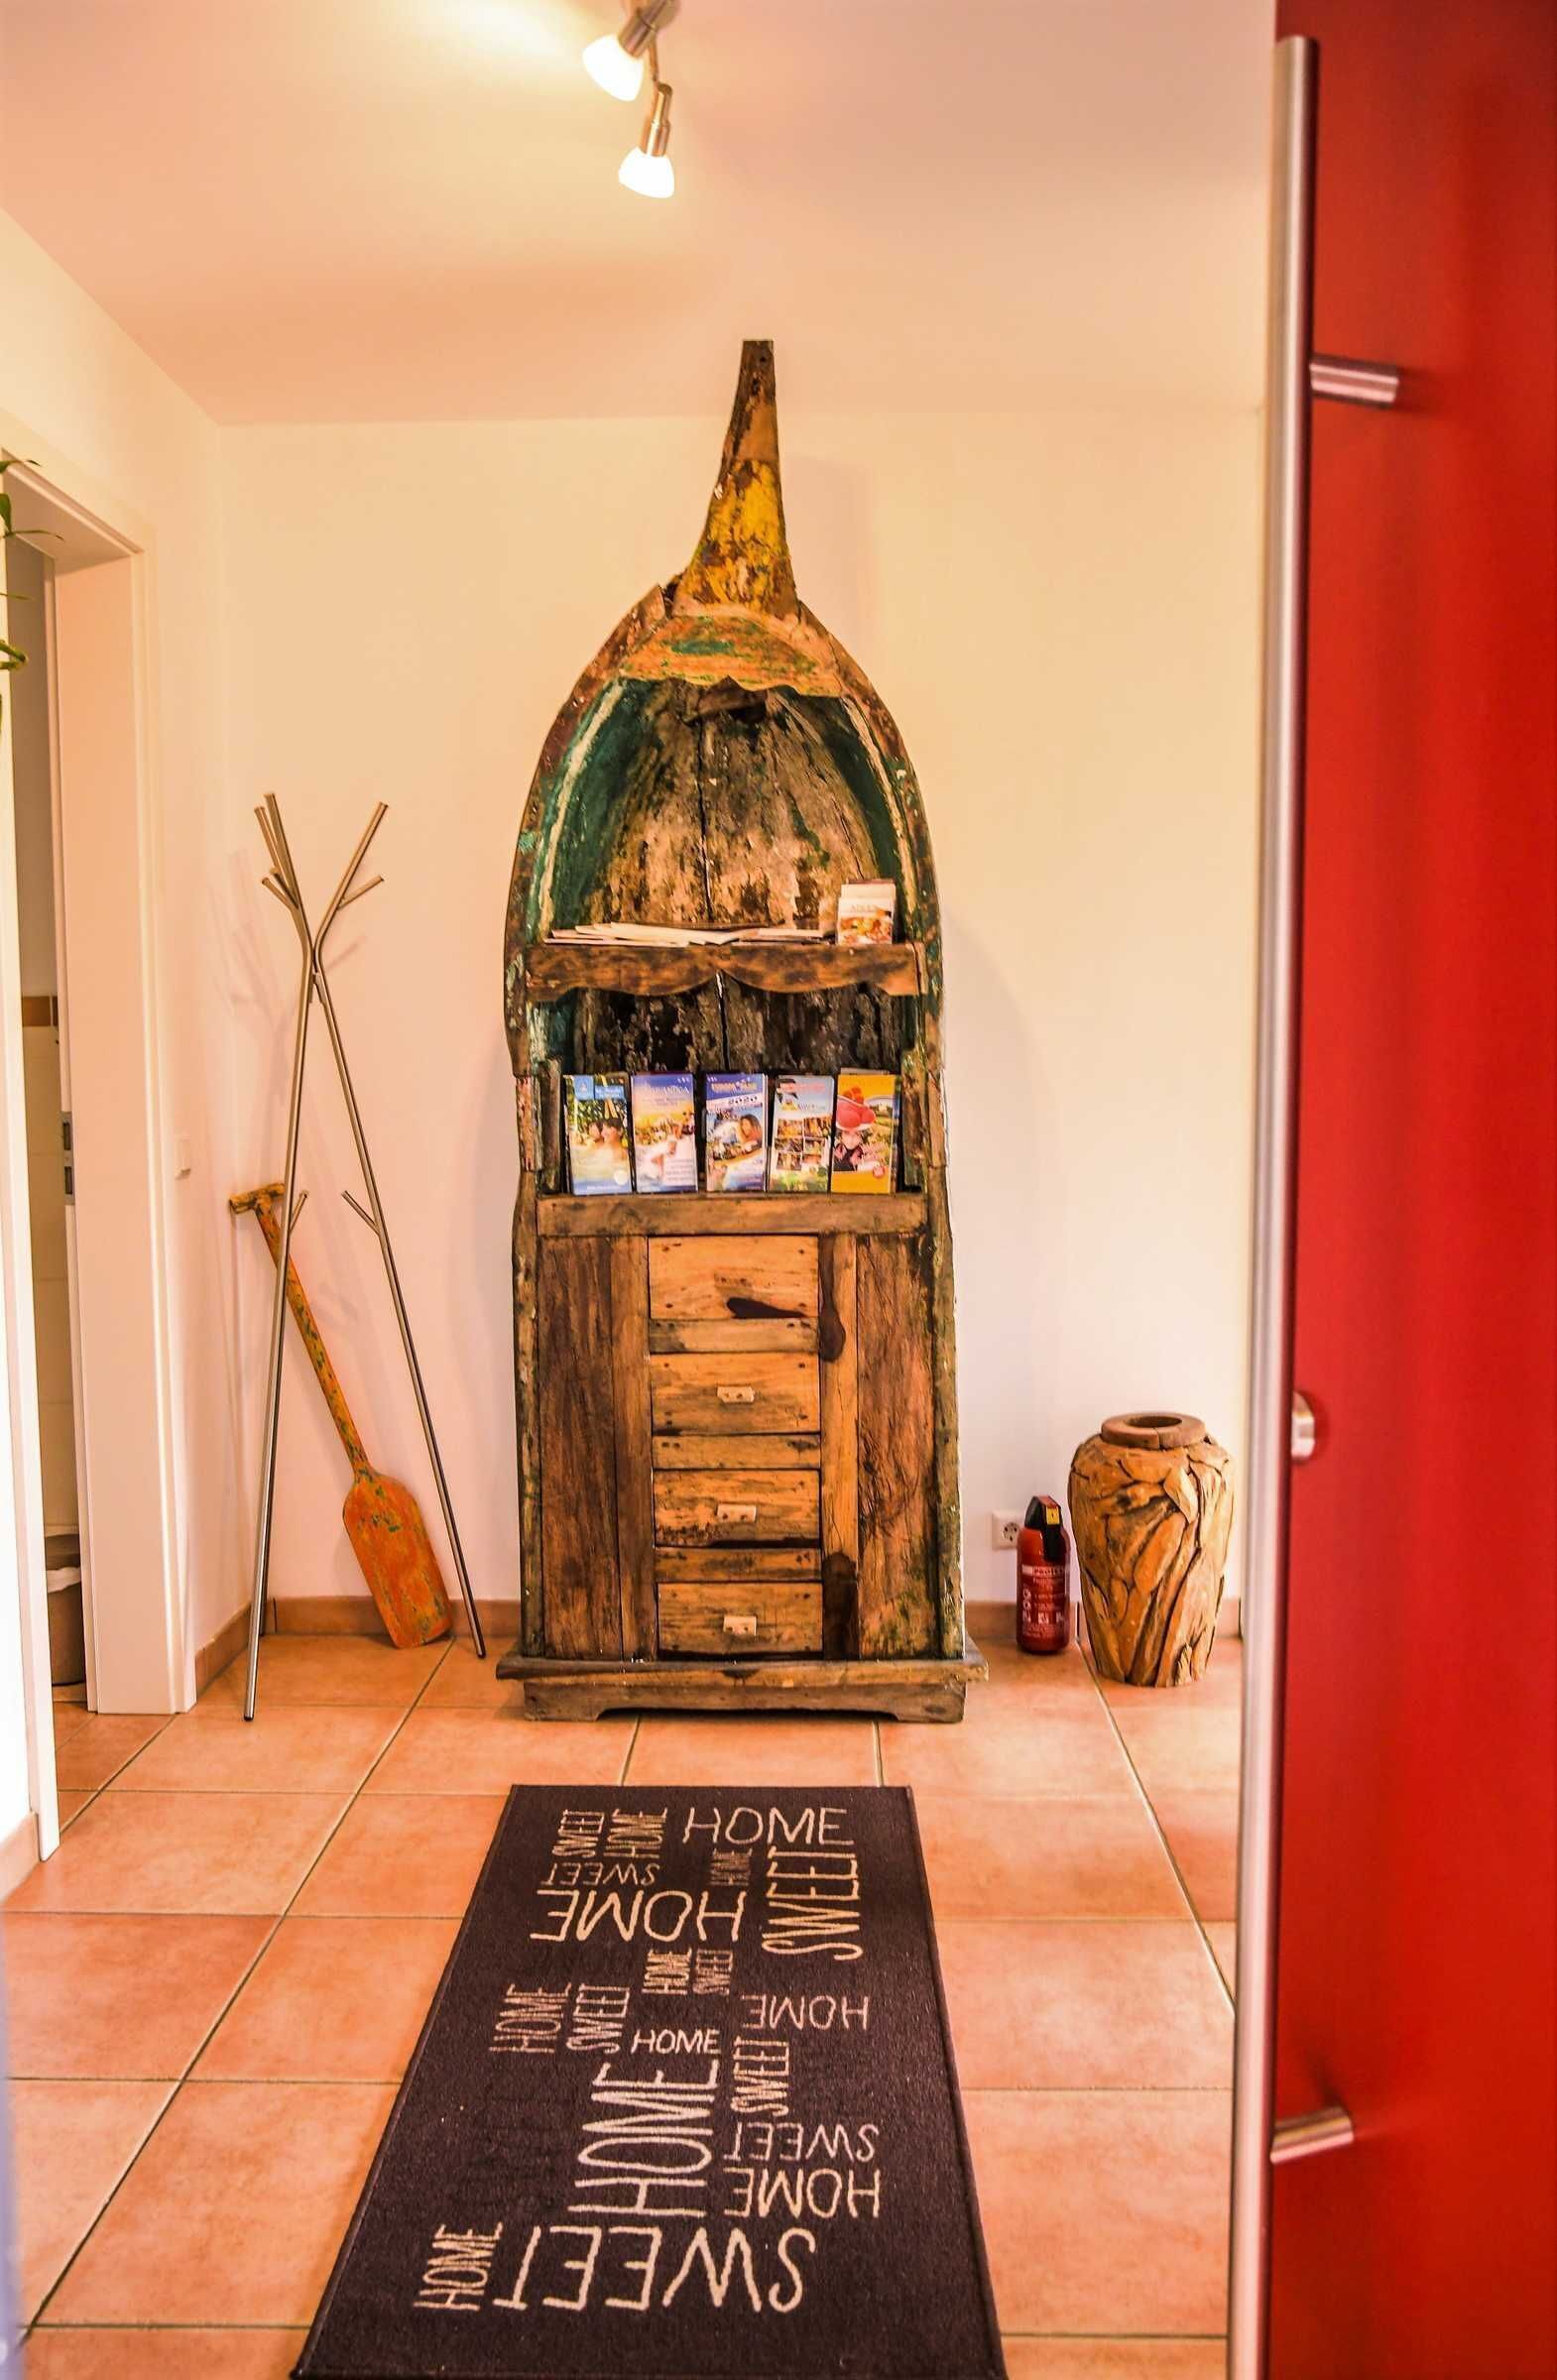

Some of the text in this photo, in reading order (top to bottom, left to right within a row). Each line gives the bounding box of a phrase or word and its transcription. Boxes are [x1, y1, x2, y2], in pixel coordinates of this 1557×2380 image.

[552, 1808, 604, 1857] SWEET
[602, 1808, 668, 1859] HOME
[681, 1807, 855, 1845] HOME
[540, 1862, 660, 1885] SWEET
[529, 1889, 747, 1943] HOME
[761, 1845, 864, 1961] SWEET
[641, 1947, 693, 1996] HOME
[489, 1982, 571, 2054] HOME
[565, 1982, 631, 2055] SWEET
[740, 1993, 871, 2031] HOME
[630, 2028, 722, 2055] HOME
[729, 2035, 790, 2117] SWEET
[567, 2059, 720, 2217] HOME
[723, 2121, 880, 2163] SWEET
[722, 2166, 882, 2219] HOME
[414, 2222, 503, 2311] HOME
[493, 2225, 816, 2313] SWEET
